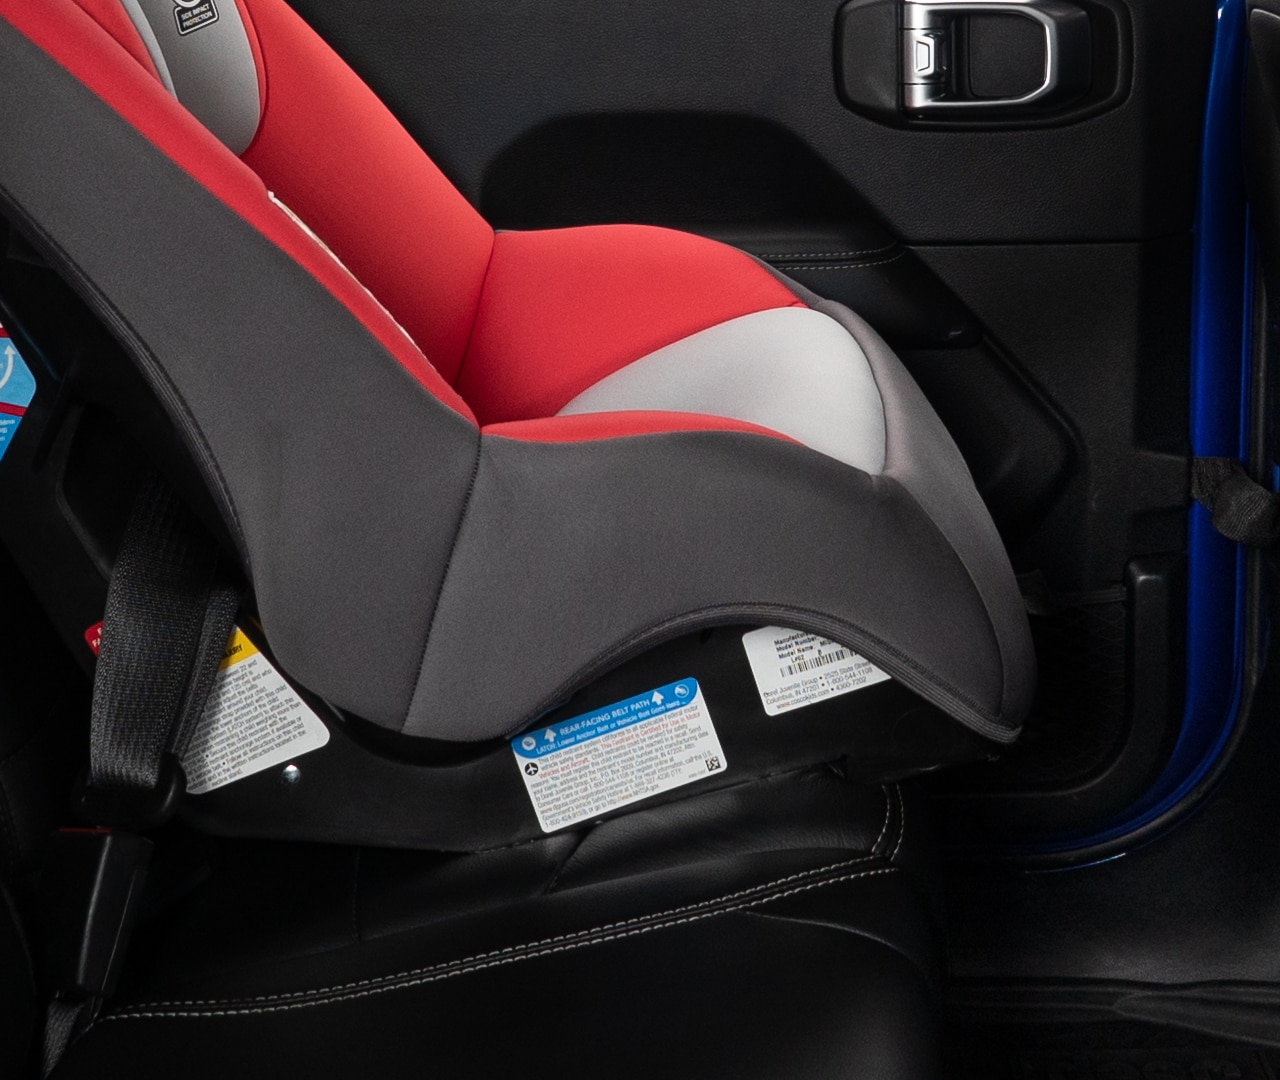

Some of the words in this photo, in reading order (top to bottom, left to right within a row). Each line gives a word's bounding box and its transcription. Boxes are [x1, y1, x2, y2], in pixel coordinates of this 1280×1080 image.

[181, 11, 192, 20] SIDE
[192, 3, 210, 15] IMPACT
[183, 11, 212, 28] PROTECTION
[775, 642, 793, 652] Model
[777, 649, 795, 659] Model
[558, 711, 611, 736] REAR-FACING
[610, 705, 629, 718] BELT
[629, 698, 650, 711] PATH
